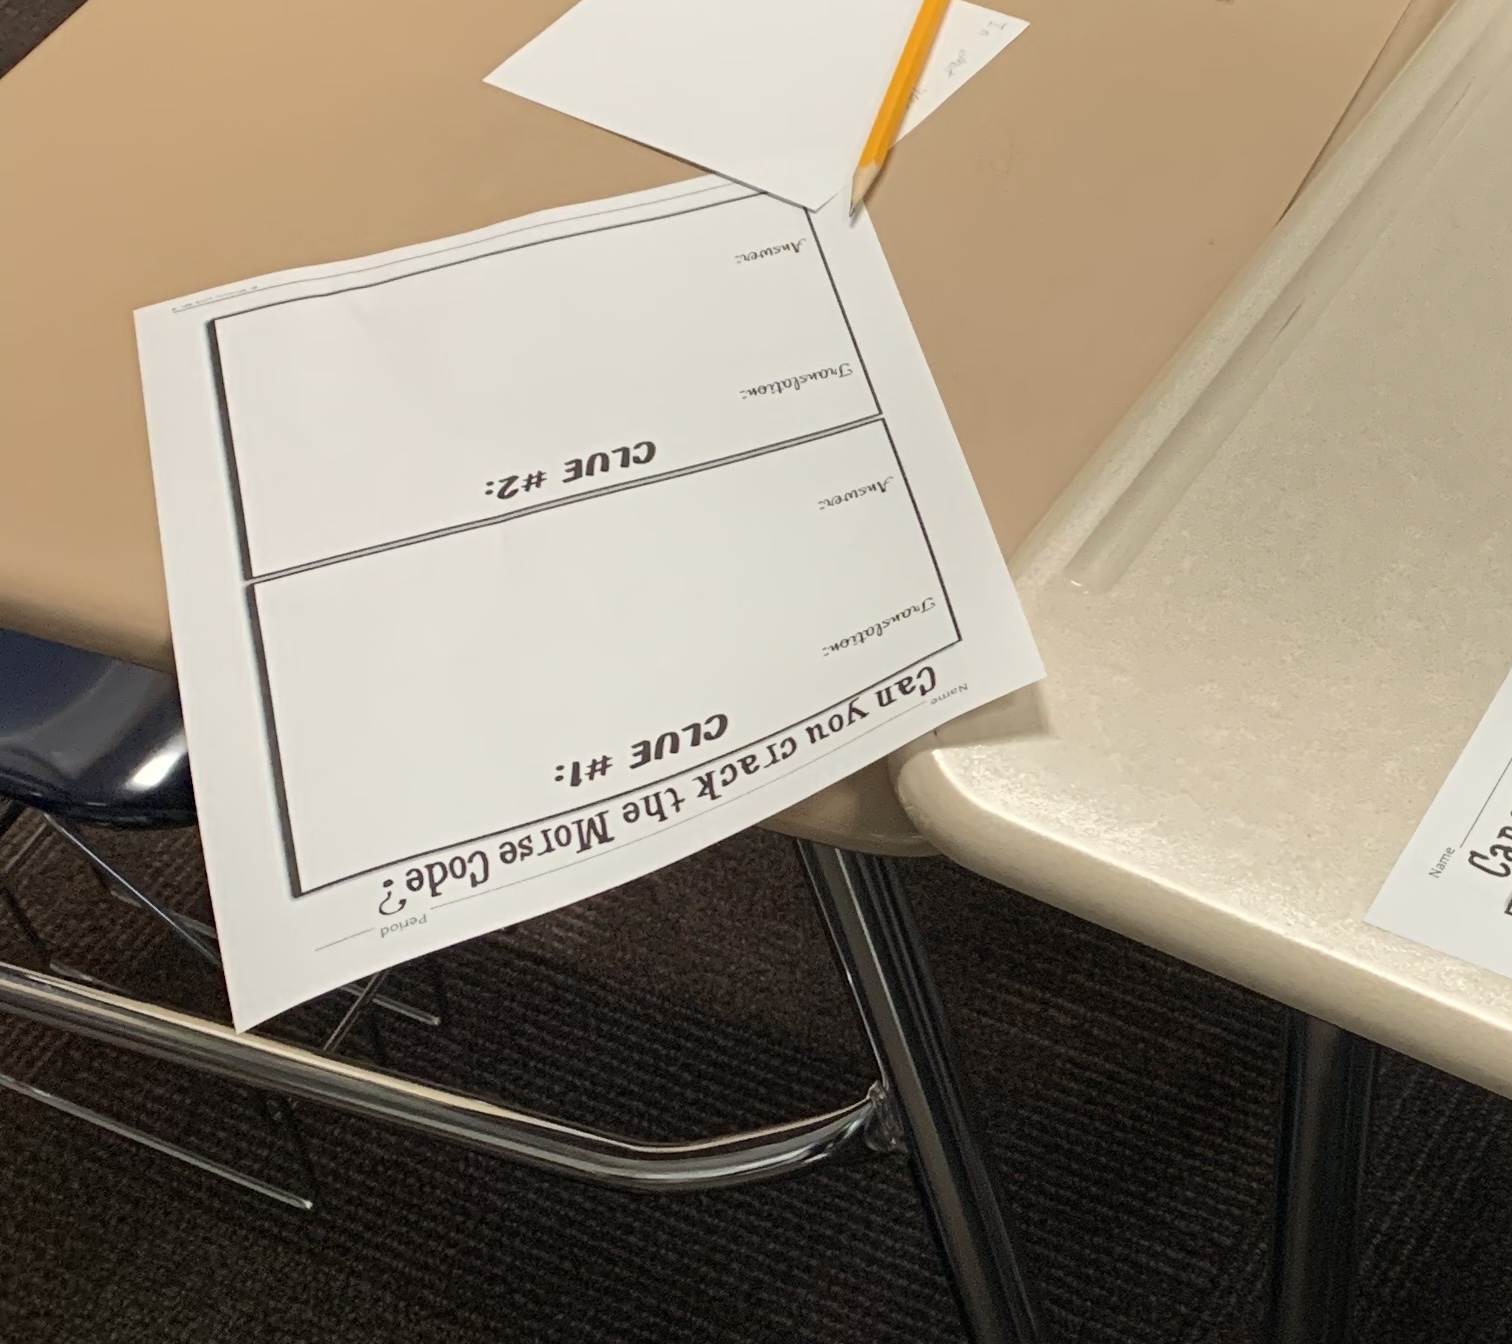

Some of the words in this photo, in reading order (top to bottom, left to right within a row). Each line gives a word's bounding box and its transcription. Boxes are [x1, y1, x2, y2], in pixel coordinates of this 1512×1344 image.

[735, 239, 805, 263] Answer:
[741, 363, 852, 399] Translation:
[563, 441, 656, 483] CLUE
[485, 471, 546, 499] #2:
[819, 477, 892, 510] Answer:
[823, 597, 935, 656] Translation:
[873, 667, 936, 707] Can
[931, 683, 968, 705] Name
[802, 698, 868, 743] you
[631, 714, 728, 768] CLUE
[555, 756, 612, 787] #1:
[694, 738, 796, 800] crack
[623, 788, 684, 823] the
[500, 801, 614, 864] Morse
[1428, 847, 1455, 878] Name
[379, 851, 489, 915] Code?
[380, 914, 427, 938] Period
